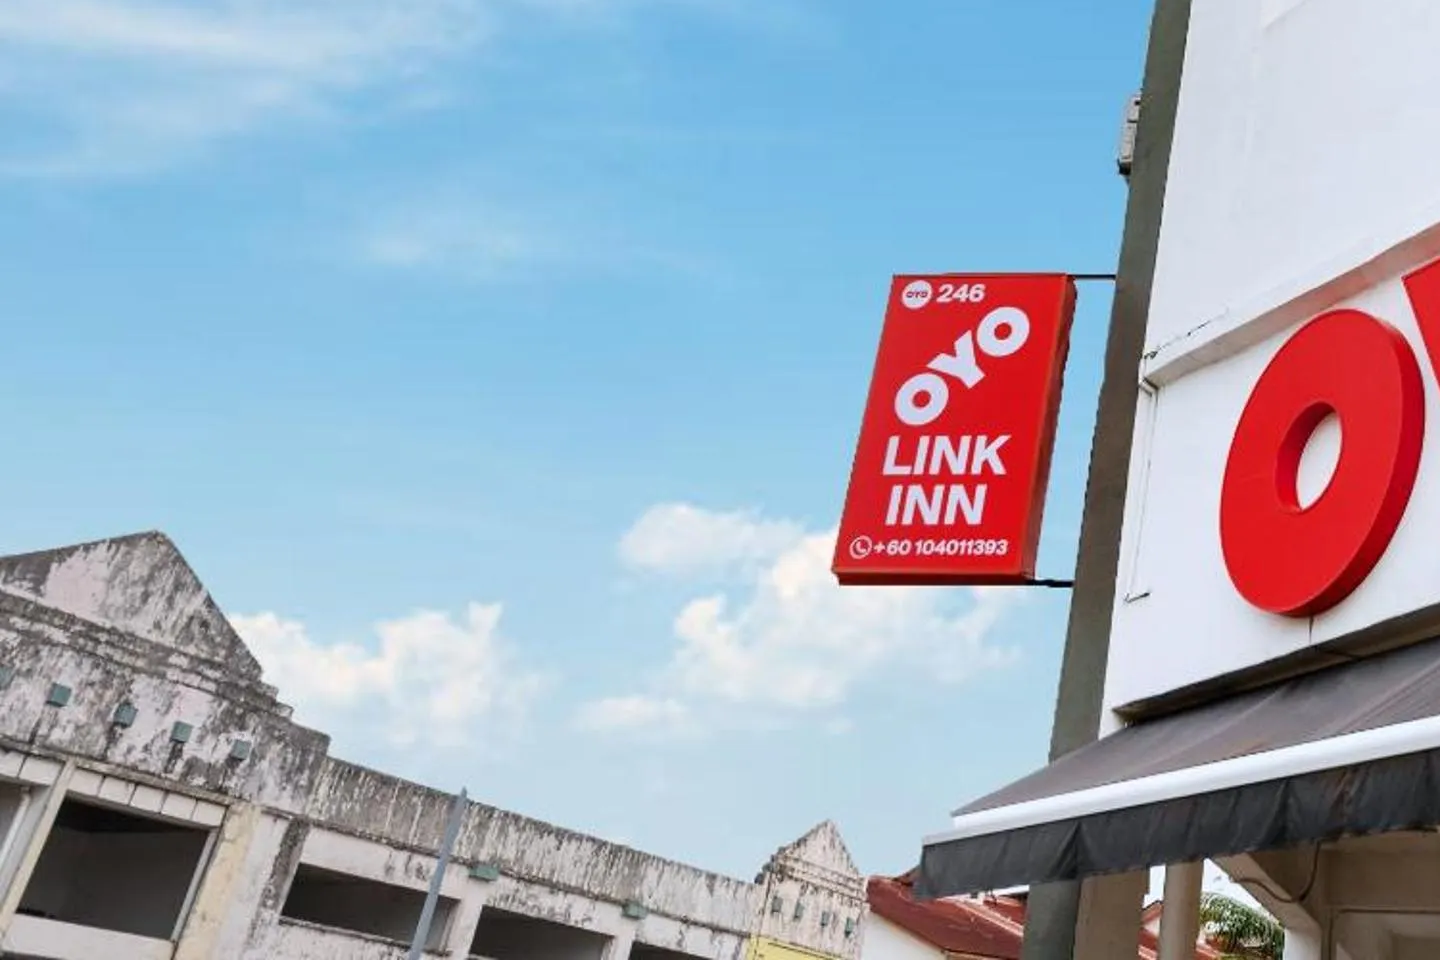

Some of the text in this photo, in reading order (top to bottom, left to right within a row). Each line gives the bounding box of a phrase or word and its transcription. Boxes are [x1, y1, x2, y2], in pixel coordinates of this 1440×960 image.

[936, 283, 986, 303] 246
[894, 306, 1030, 426] OYO
[882, 435, 1011, 476] LINK
[885, 484, 988, 526] INN
